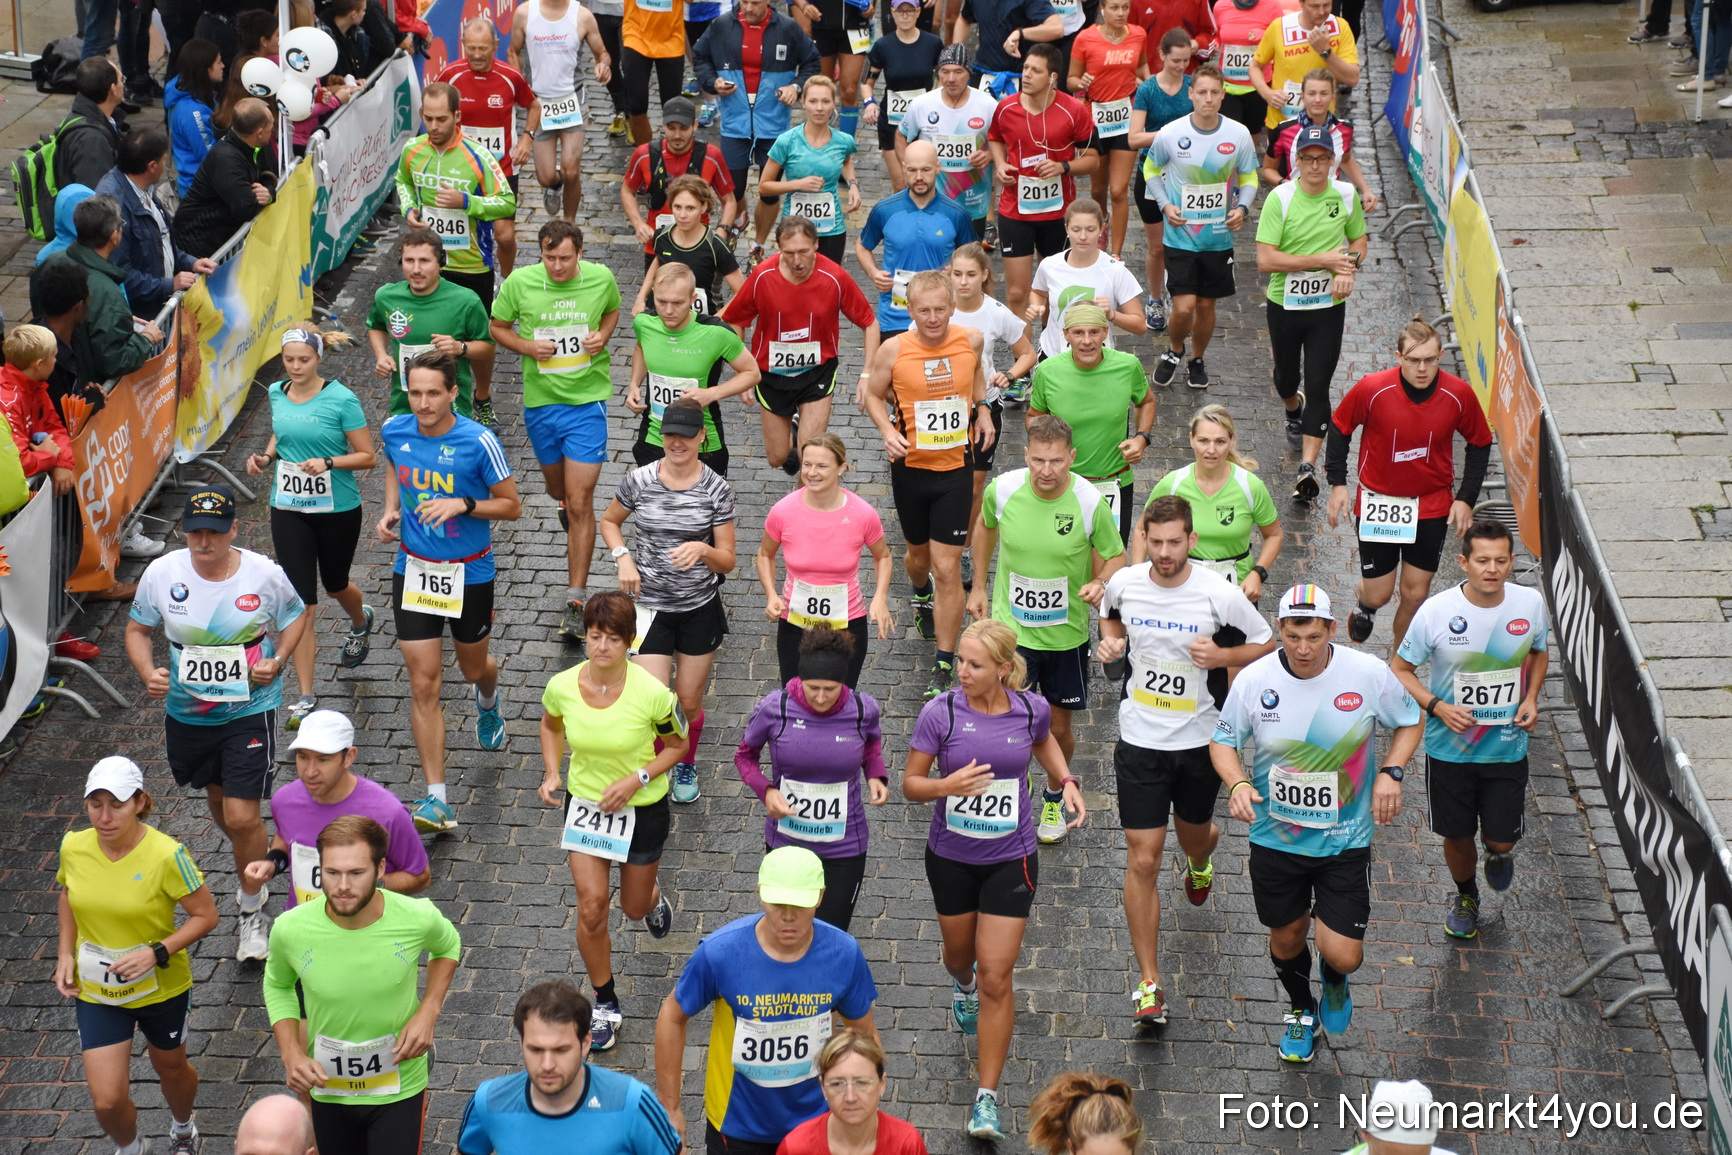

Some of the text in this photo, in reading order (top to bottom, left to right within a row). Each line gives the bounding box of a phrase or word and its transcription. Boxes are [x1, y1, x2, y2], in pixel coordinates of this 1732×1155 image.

[1104, 50, 1133, 65] NIKE
[1284, 46, 1310, 57] MAX
[543, 98, 576, 118] 2899
[1097, 106, 1129, 123] 2802
[937, 142, 974, 158] 2398
[1022, 183, 1060, 200] 2012
[1186, 193, 1224, 209] 2452
[795, 202, 832, 218] 2662
[426, 217, 465, 235] 2846
[1290, 278, 1331, 295] 2097
[553, 300, 576, 309] JONI
[1297, 297, 1320, 305] Ludwig
[549, 312, 587, 321] LÄUFER
[551, 336, 580, 354] 13
[775, 352, 816, 368] 2644
[651, 384, 682, 406] 205
[926, 411, 961, 432] 218
[933, 434, 954, 443] Ralph
[282, 474, 327, 495] 2046
[398, 465, 454, 494] RUN
[290, 497, 317, 507] Andrea
[1366, 503, 1413, 524] 2583
[1373, 527, 1401, 536] Manuel
[418, 572, 451, 595] 165
[239, 598, 260, 608] Hervis
[417, 596, 448, 609] Andreas
[1014, 587, 1063, 609] 2632
[168, 603, 188, 611] PARTL
[807, 597, 831, 616] 86
[1024, 612, 1051, 621] Rainer
[1131, 617, 1199, 633] DELPHI
[1509, 622, 1529, 631] Hervis
[186, 659, 242, 682] 2084
[1145, 670, 1186, 696] 229
[1337, 694, 1360, 706] Hervis
[1461, 682, 1515, 705] 2677
[1155, 697, 1171, 708] Tim
[1472, 710, 1507, 719] Rüdiger
[1275, 781, 1332, 807] 3086
[787, 794, 841, 819] 2204
[954, 795, 1012, 817] 2426
[1277, 805, 1330, 819] BERNHARD
[574, 806, 628, 836] 2411
[963, 820, 998, 832] Kristina
[581, 835, 613, 850] Brigitte
[100, 986, 135, 998] Marion
[736, 992, 832, 1006] 10. NEUMARKTER
[752, 1004, 819, 1017] STADTLAUF
[741, 1035, 809, 1062] 3056
[330, 1054, 382, 1077] 154
[348, 1081, 365, 1089] Till
